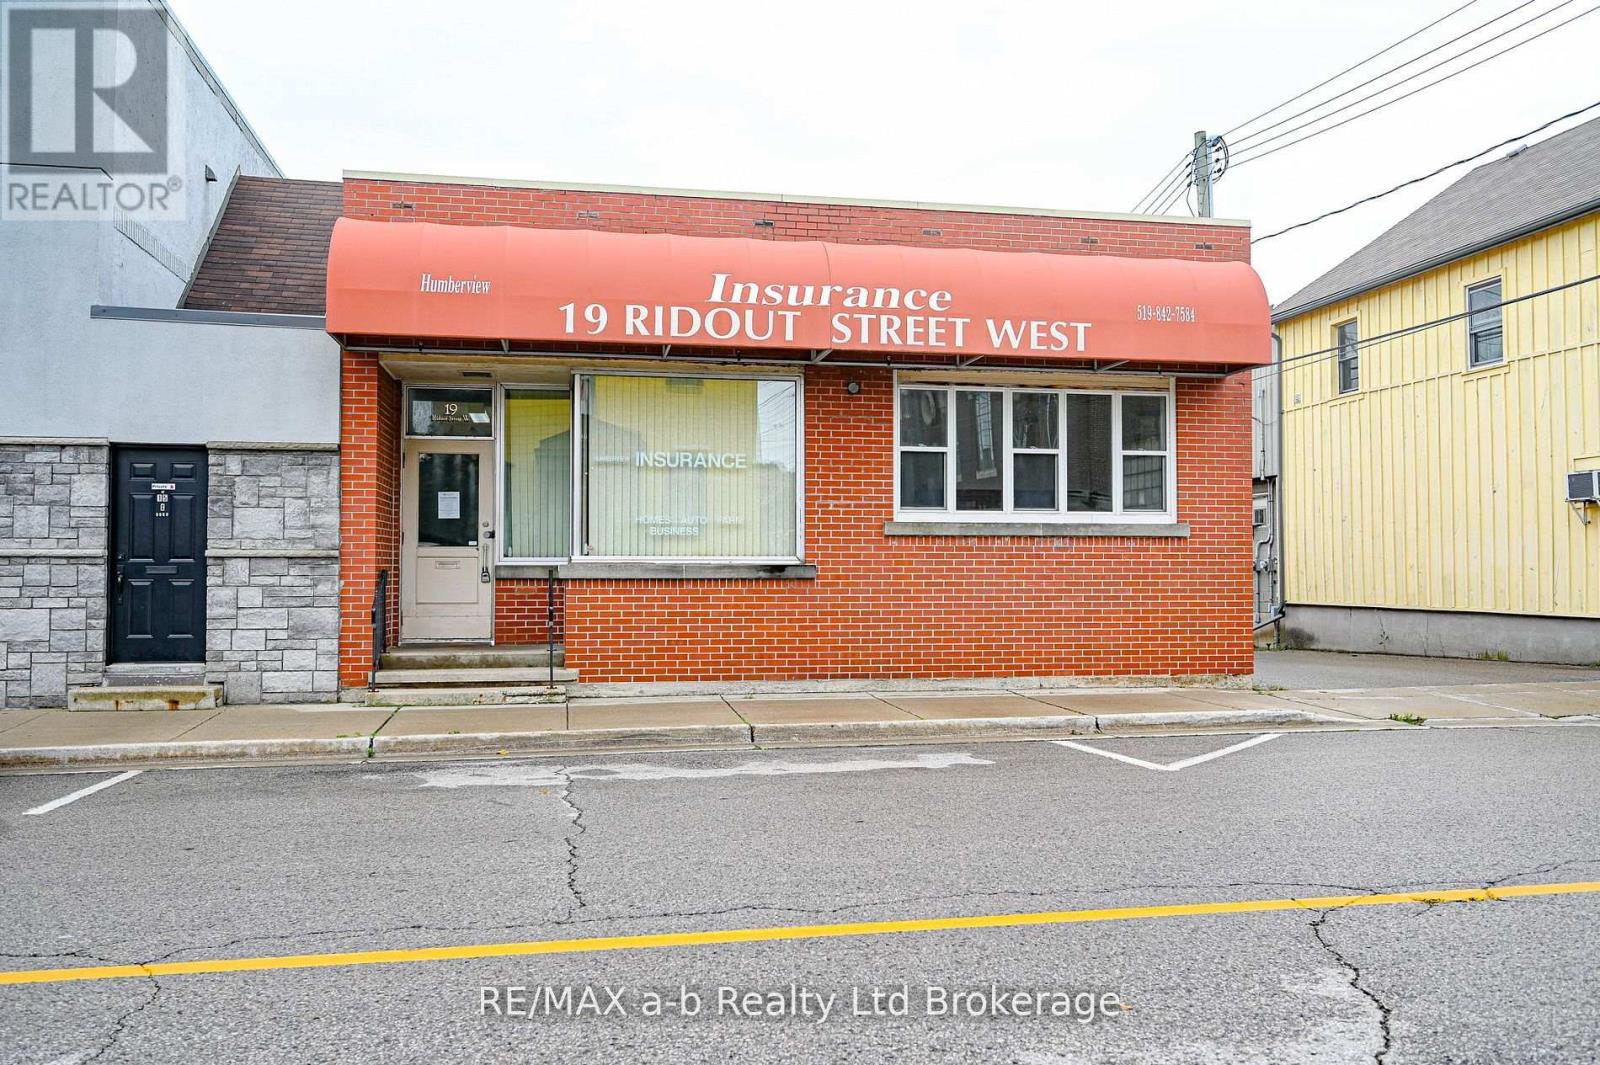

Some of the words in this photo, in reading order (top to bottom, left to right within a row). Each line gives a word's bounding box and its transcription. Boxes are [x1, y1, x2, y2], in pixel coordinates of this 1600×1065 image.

[420, 272, 492, 296] Humberview
[704, 272, 952, 311] Insurance
[1136, 303, 1197, 324] 519-842-7584
[558, 302, 609, 335] 19
[624, 303, 802, 342] RIDOUT
[830, 311, 971, 348] STREET
[985, 318, 1093, 353] WEST
[444, 403, 458, 415] 19
[635, 451, 747, 468] INSURANCE
[649, 526, 699, 536] BUSINESS
